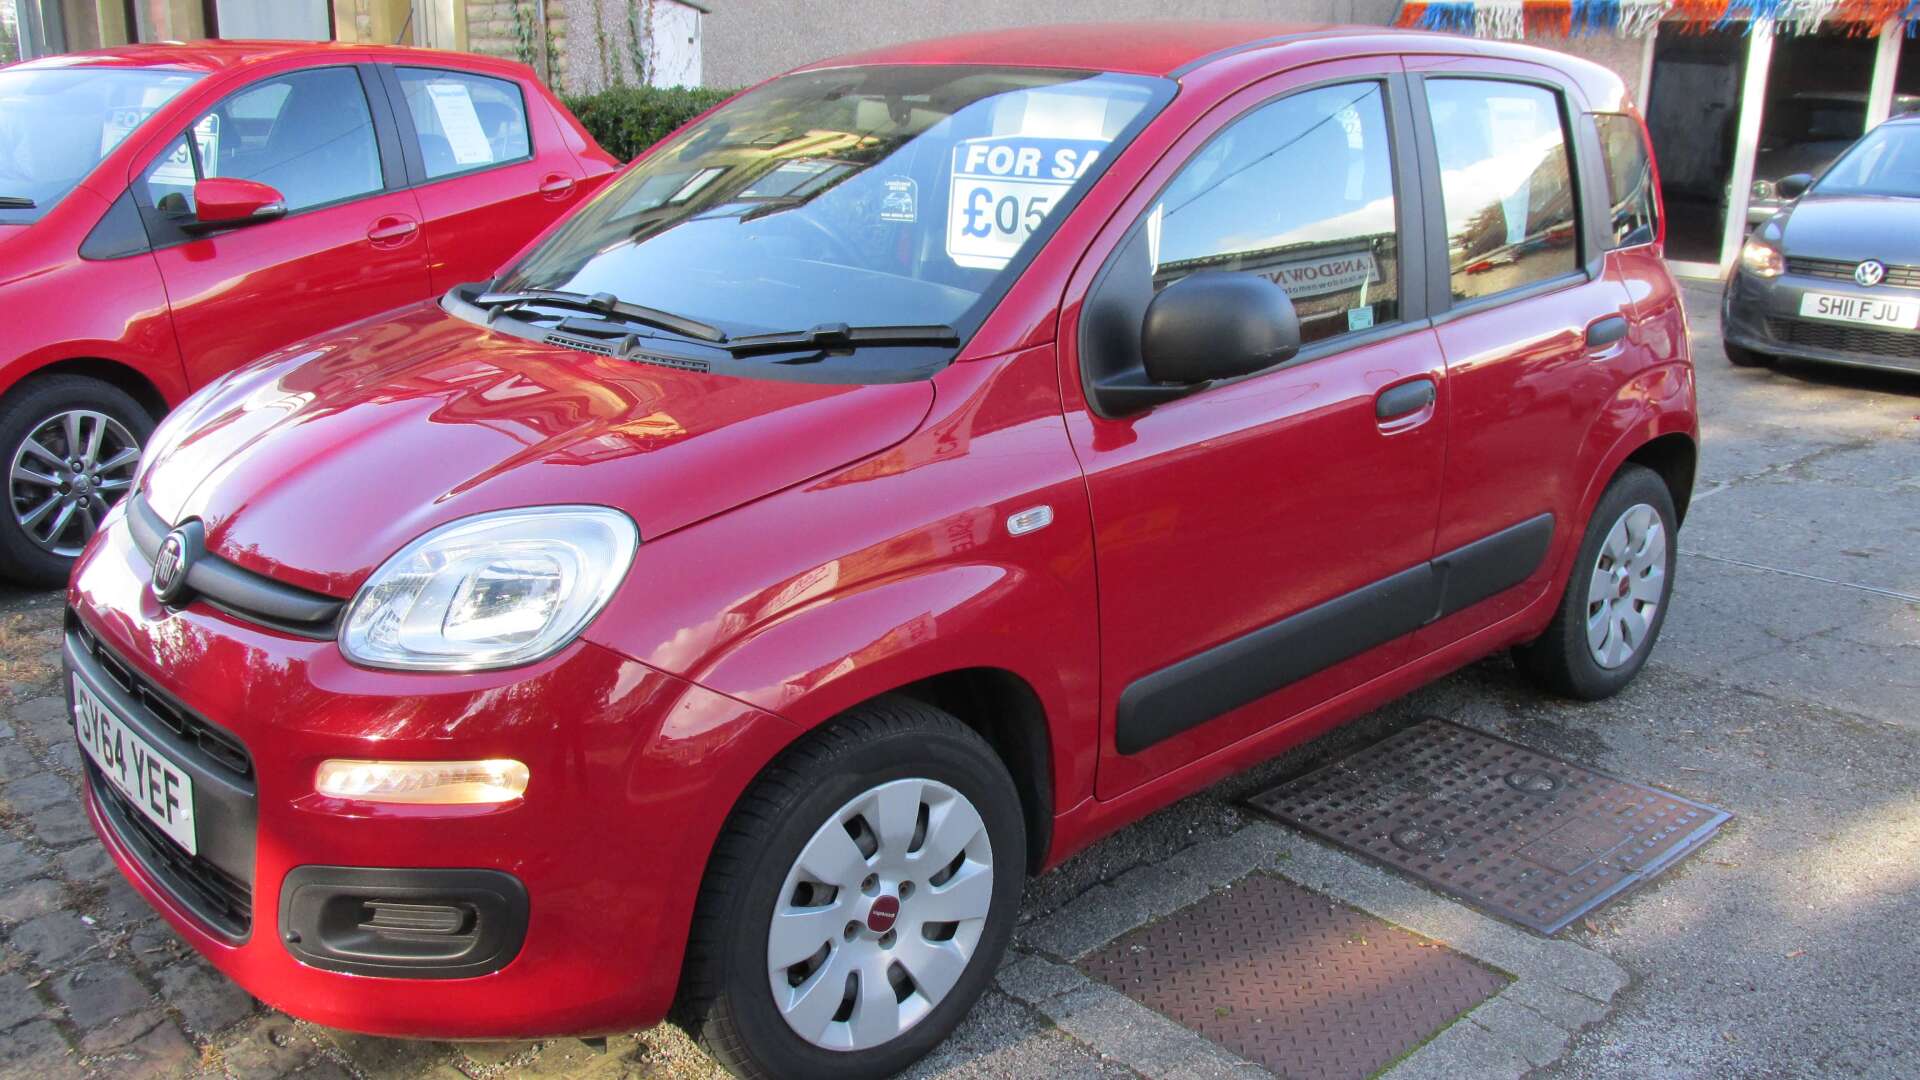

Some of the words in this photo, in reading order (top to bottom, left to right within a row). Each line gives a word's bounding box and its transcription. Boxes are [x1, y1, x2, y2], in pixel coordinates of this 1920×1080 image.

[964, 144, 1042, 176] FOR
[962, 187, 1047, 237] £05
[1858, 301, 1900, 322] FJU
[79, 688, 127, 782] SY64
[131, 741, 180, 825] YEF
